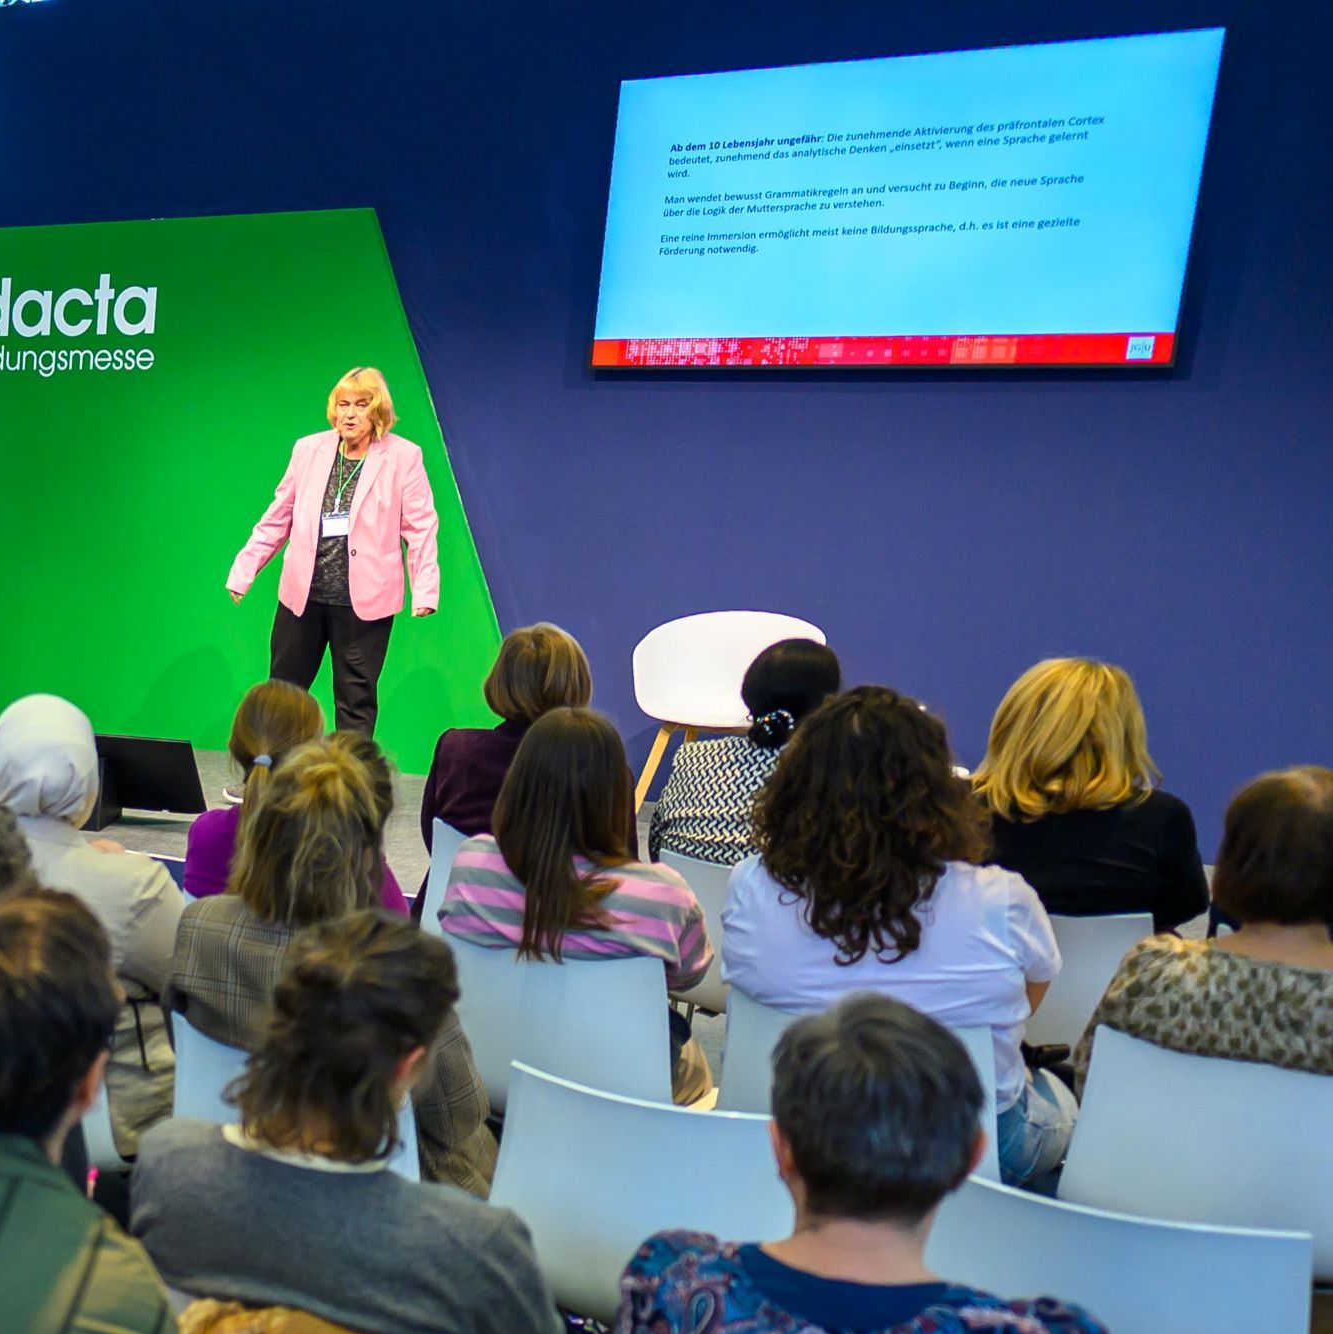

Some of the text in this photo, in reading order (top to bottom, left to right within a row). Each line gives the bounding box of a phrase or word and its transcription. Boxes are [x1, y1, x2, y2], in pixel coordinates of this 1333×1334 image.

[669, 143, 684, 153] Ab
[685, 142, 707, 152] dem
[709, 141, 721, 150] 10
[722, 137, 775, 149] Lebensjahr
[827, 133, 844, 143] Die
[845, 128, 912, 142] zunehmende
[913, 124, 974, 137] Aktivierung
[976, 122, 995, 133] des
[997, 117, 1065, 133] präfrontalen
[1068, 115, 1105, 127] Cortex
[668, 155, 713, 166] bedeutet,
[715, 151, 771, 163] zunehmend
[772, 150, 790, 160] das
[791, 147, 847, 159] analytische
[849, 144, 887, 154] Denken
[945, 140, 974, 150] wenn
[976, 137, 1001, 147] eine
[1003, 131, 1046, 146] Sprache
[1048, 130, 1089, 144] gelernt
[667, 169, 691, 179] wird.
[664, 174, 1085, 205] Man wendet bewusst Grammatikregeln an und versucht zu Beginn, die neue Sprache
[663, 199, 885, 218] über die Logik der Muttersprache zu verstehen.
[660, 234, 680, 243] Eine
[682, 233, 706, 242] reine
[707, 230, 757, 242] Immersion
[758, 228, 810, 240] ermöglicht
[812, 227, 839, 237] meist
[841, 225, 868, 236] keine
[981, 221, 994, 230] es
[996, 220, 1009, 229] ist
[1011, 219, 1035, 229] eine
[1037, 217, 1081, 230] gezielte
[659, 244, 759, 256] Förderung notwendig.
